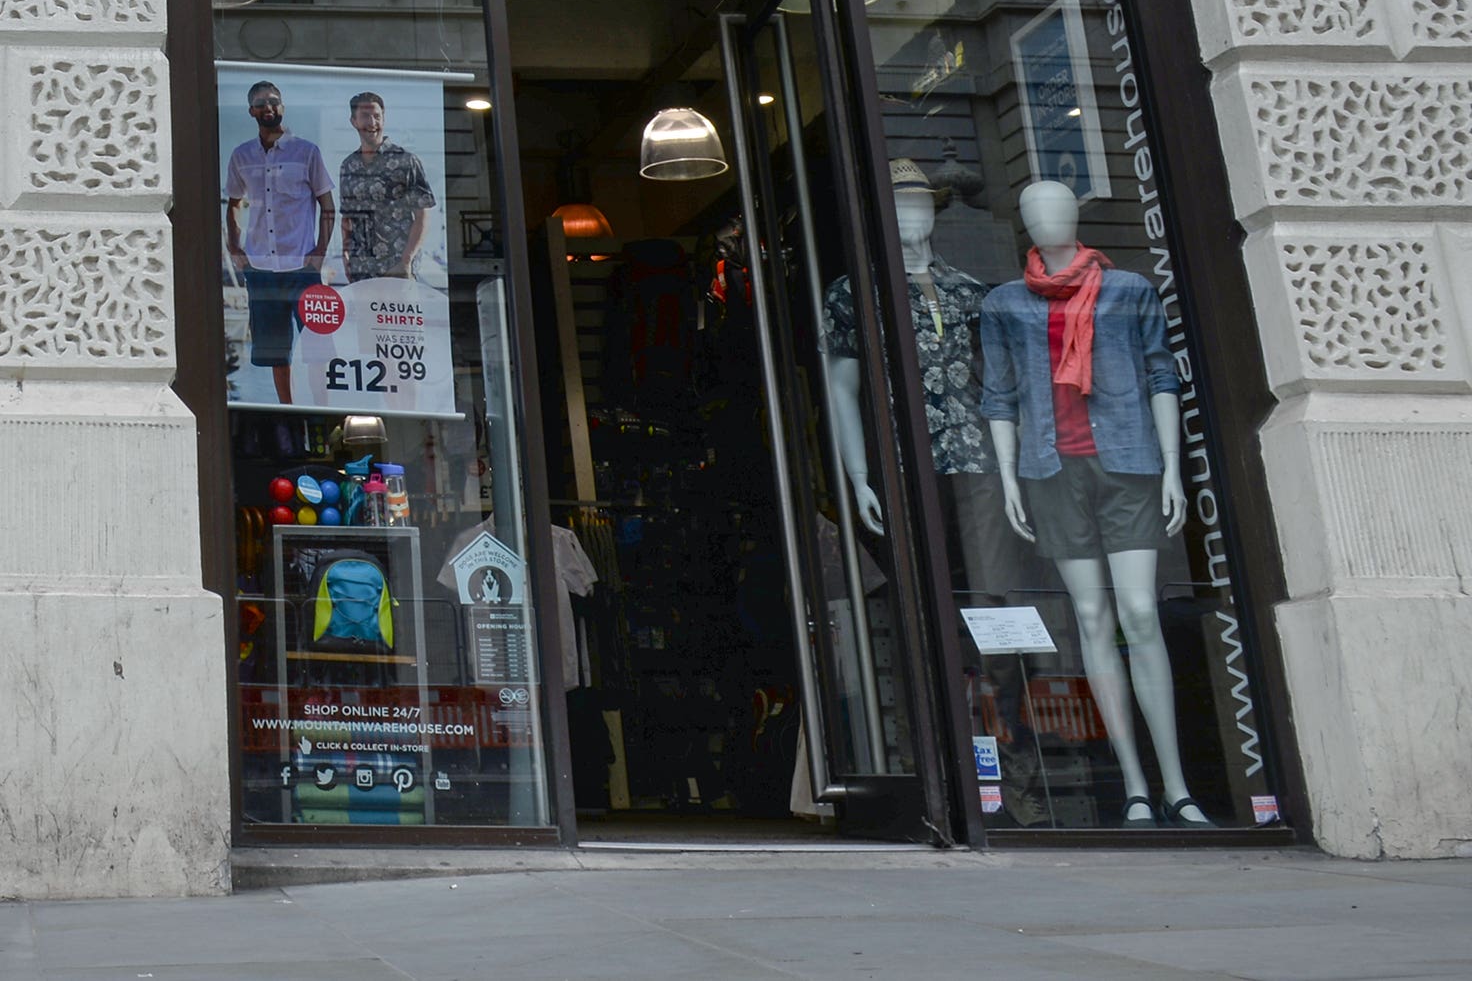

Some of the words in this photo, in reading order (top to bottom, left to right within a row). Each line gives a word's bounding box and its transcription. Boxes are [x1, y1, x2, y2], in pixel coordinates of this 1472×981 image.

[304, 300, 339, 312] HALF
[370, 302, 423, 314] CASUAL
[305, 313, 339, 325] PRICE
[376, 314, 424, 326] SHIRTS
[376, 334, 397, 343] WAS
[376, 343, 425, 360] NOW
[326, 358, 426, 393] £12.99
[488, 551, 518, 568] WELCOME
[489, 557, 508, 568] STORE
[304, 705, 338, 715] SHOP
[342, 706, 389, 717] ONLINE
[393, 707, 421, 719] 24/7
[252, 719, 474, 736] WWW.MOUNTAINWAREHOUSE.COM
[316, 742, 341, 750] CLICK
[350, 743, 388, 752] COLLECT
[390, 744, 429, 753] IN-STORE
